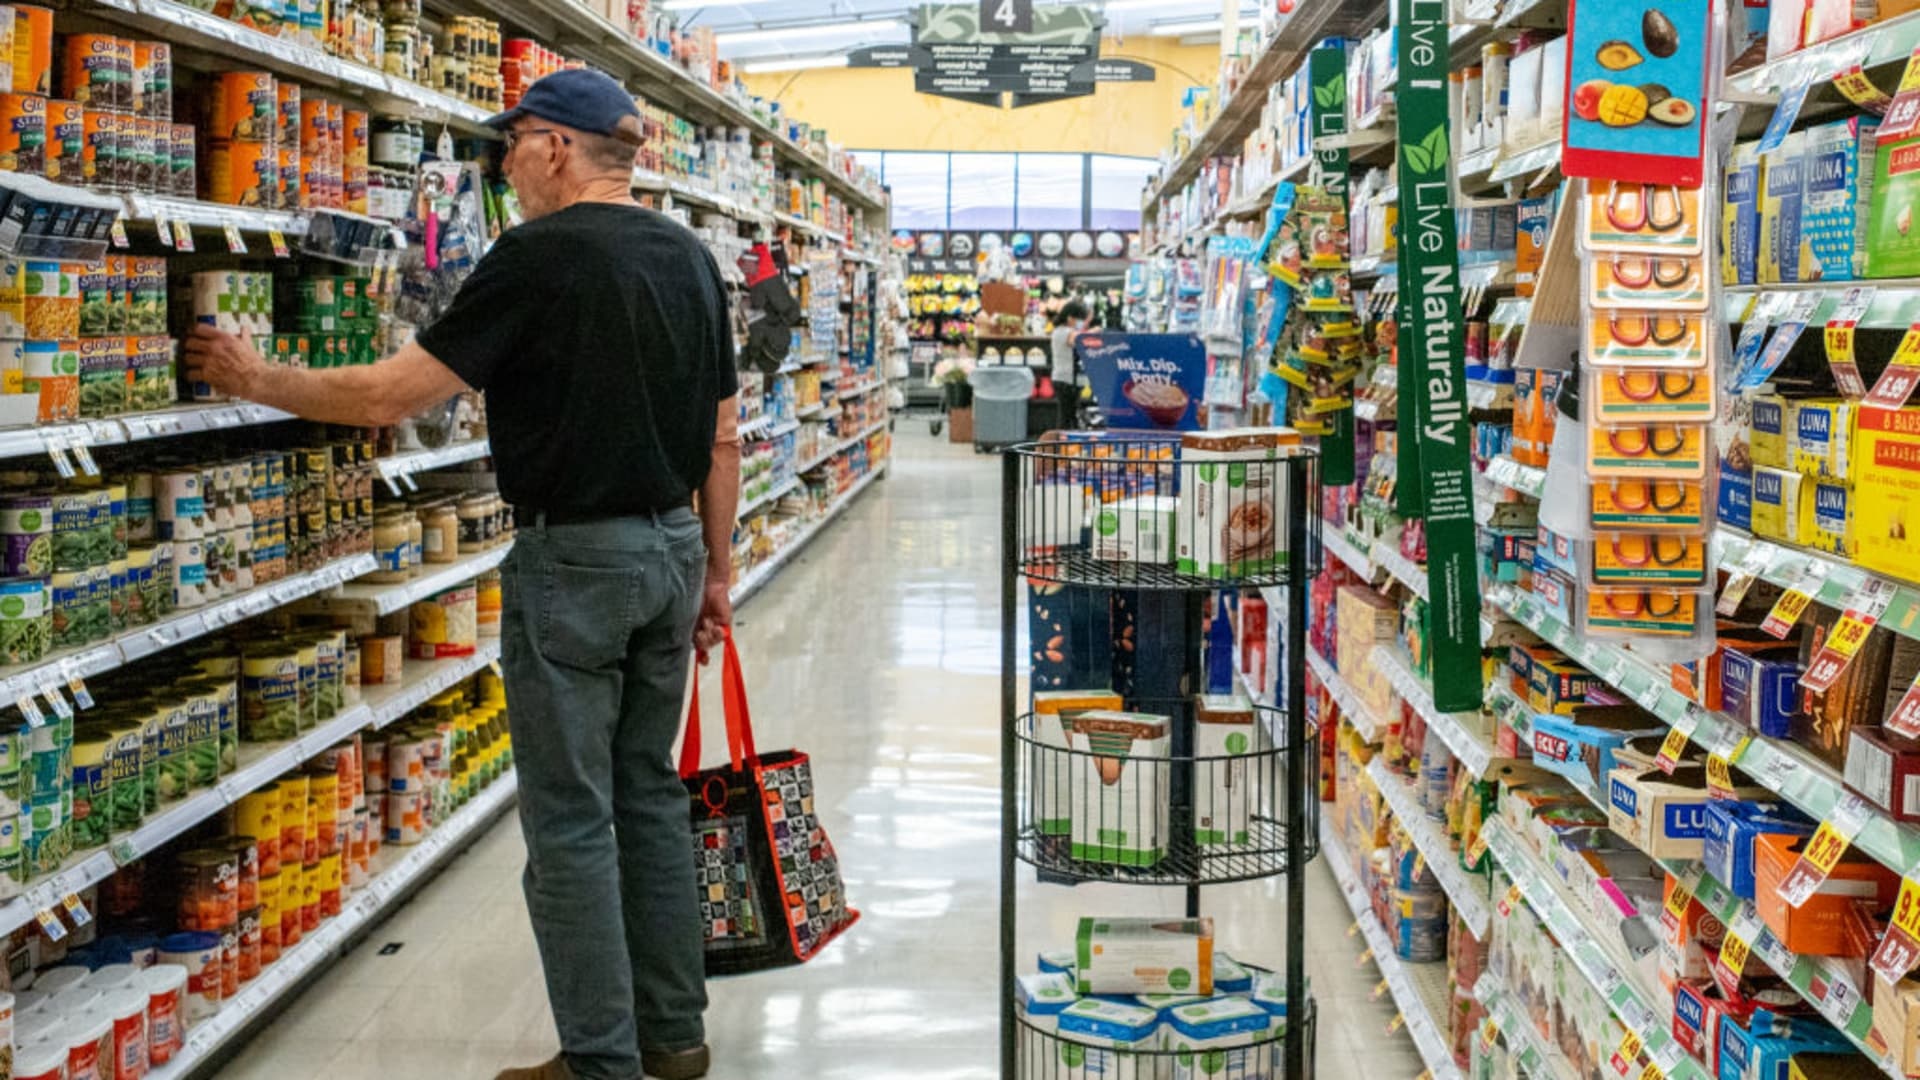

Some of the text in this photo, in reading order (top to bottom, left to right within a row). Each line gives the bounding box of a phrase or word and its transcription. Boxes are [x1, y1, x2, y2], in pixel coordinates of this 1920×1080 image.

[993, 0, 1016, 27] 4
[1320, 113, 1345, 163] Lie
[1770, 166, 1798, 188] LUNA
[1809, 157, 1843, 181] LUNA
[1728, 175, 1749, 194] LUNA
[1416, 182, 1462, 445] Live Naturally
[1117, 357, 1182, 373] Mix. Dip.
[1130, 371, 1177, 387] Party.
[1754, 405, 1779, 424] LUNA
[1800, 412, 1828, 433] LUNA
[1757, 476, 1780, 498] LUNA
[1818, 487, 1844, 511] LUNA
[1726, 660, 1745, 682] LUNA
[1612, 783, 1635, 808] LUNA
[1674, 809, 1706, 830] LU
[1808, 830, 1843, 868] 9.79
[1898, 890, 1920, 937] 9.7
[1679, 993, 1701, 1025] LUNA
[1726, 1029, 1745, 1062] LUNA
